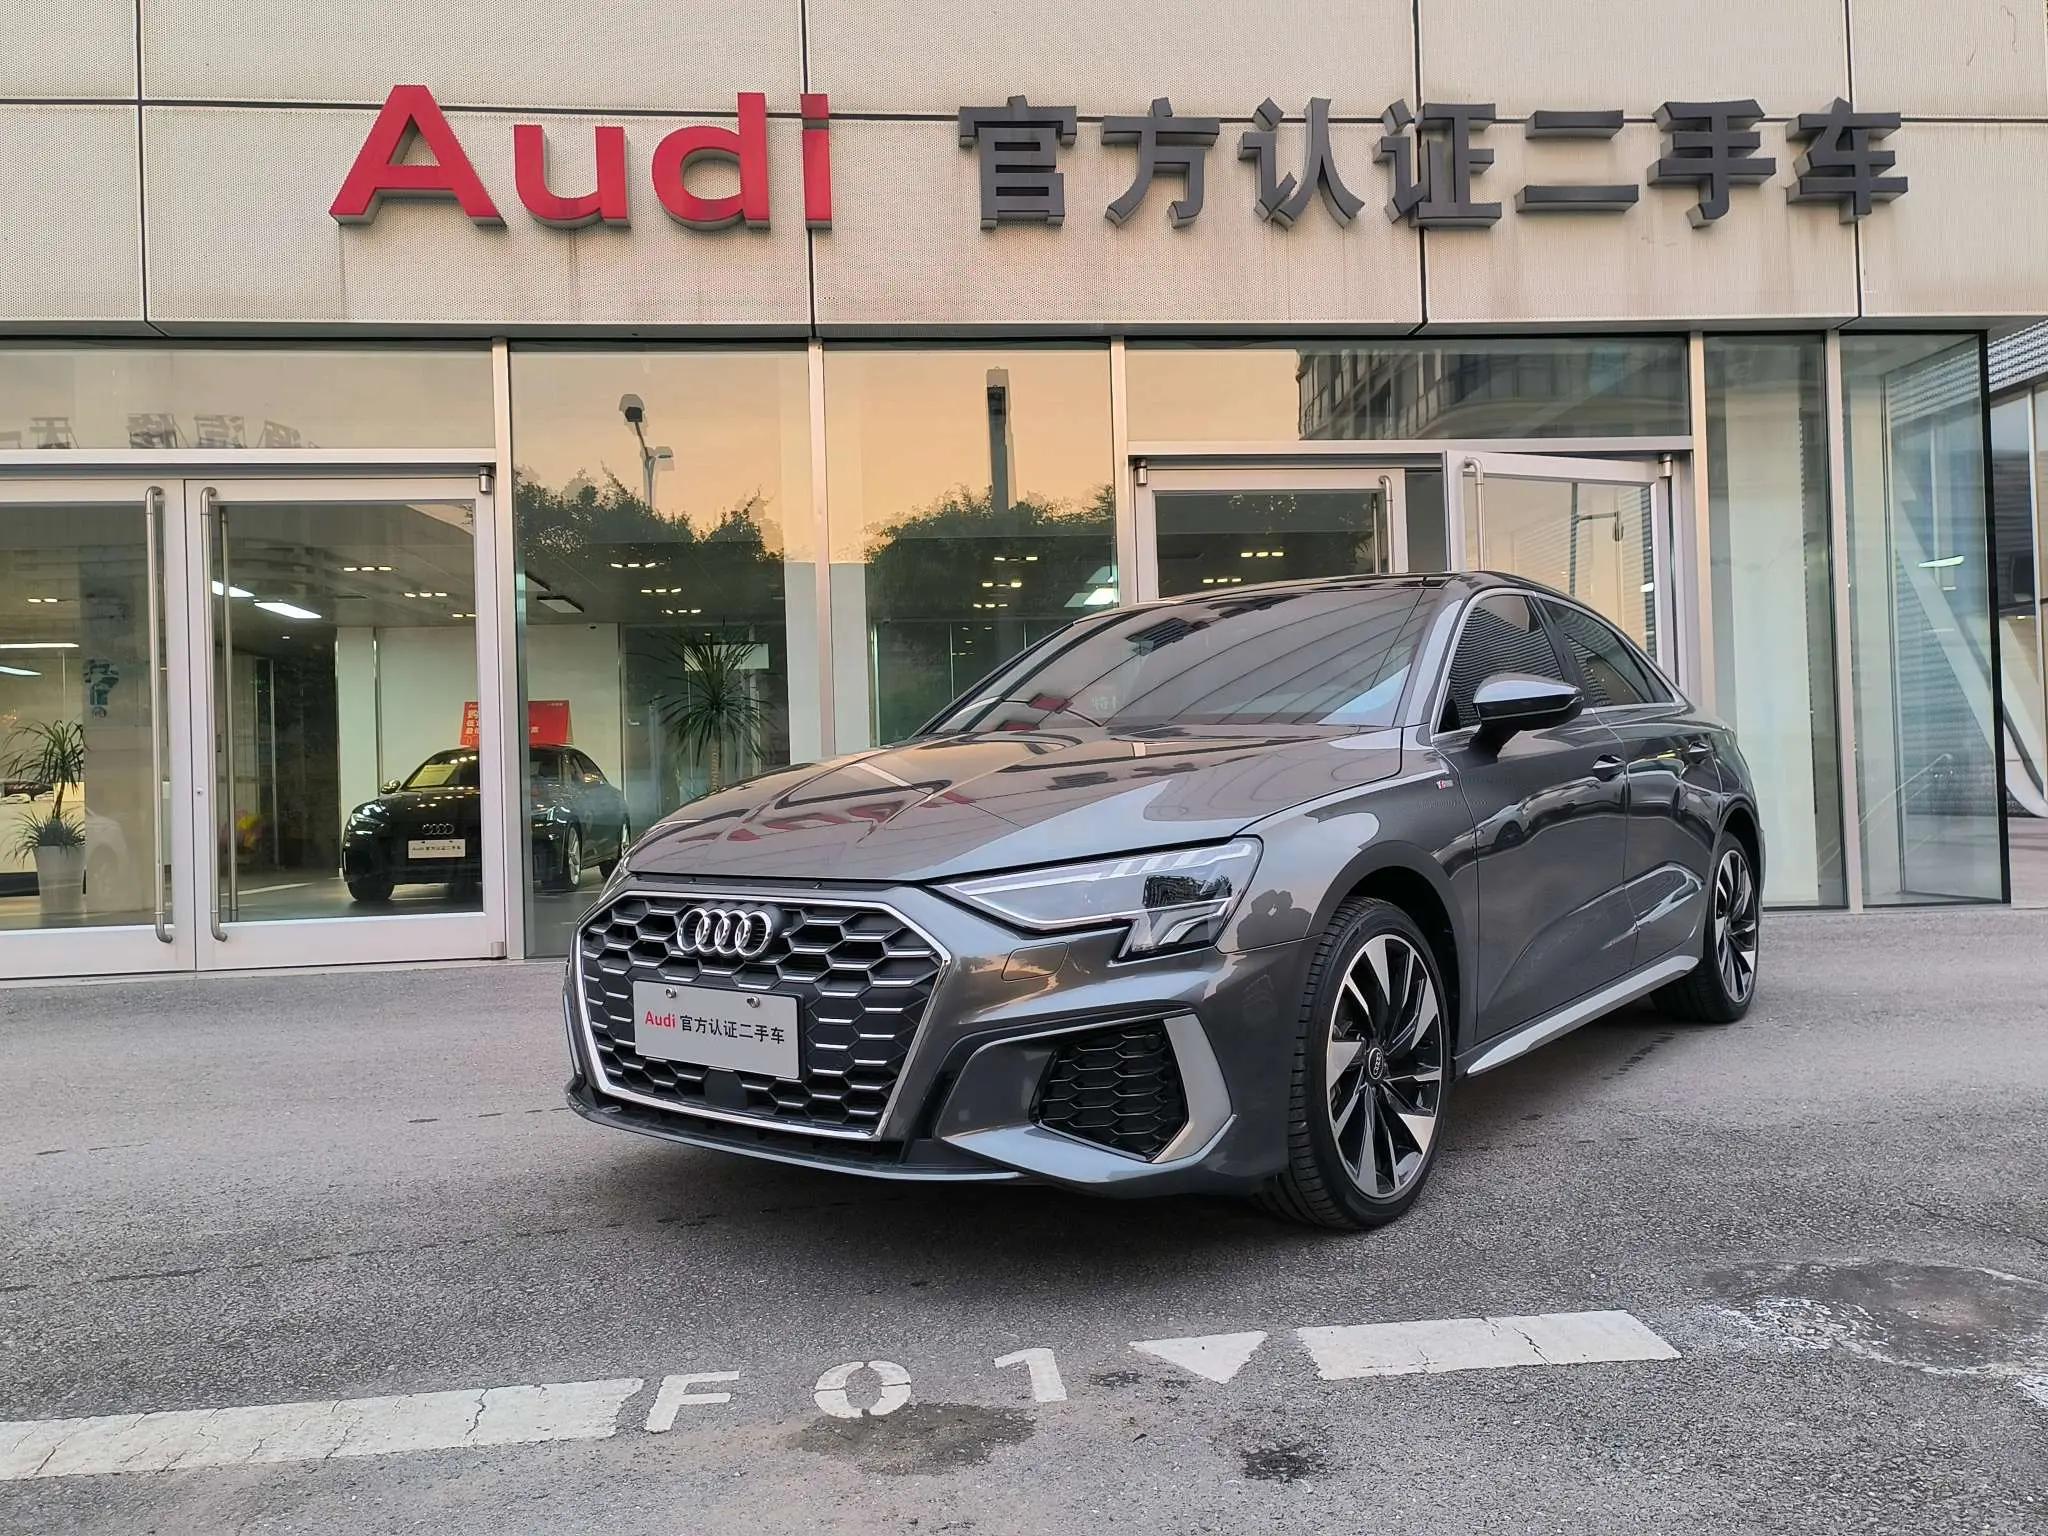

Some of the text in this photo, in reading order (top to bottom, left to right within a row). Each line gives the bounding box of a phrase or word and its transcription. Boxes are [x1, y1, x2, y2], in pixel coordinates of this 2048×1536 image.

[330, 85, 1908, 229] Audi 官方认证二手车
[645, 1011, 785, 1044] Audi 官方认证二手车
